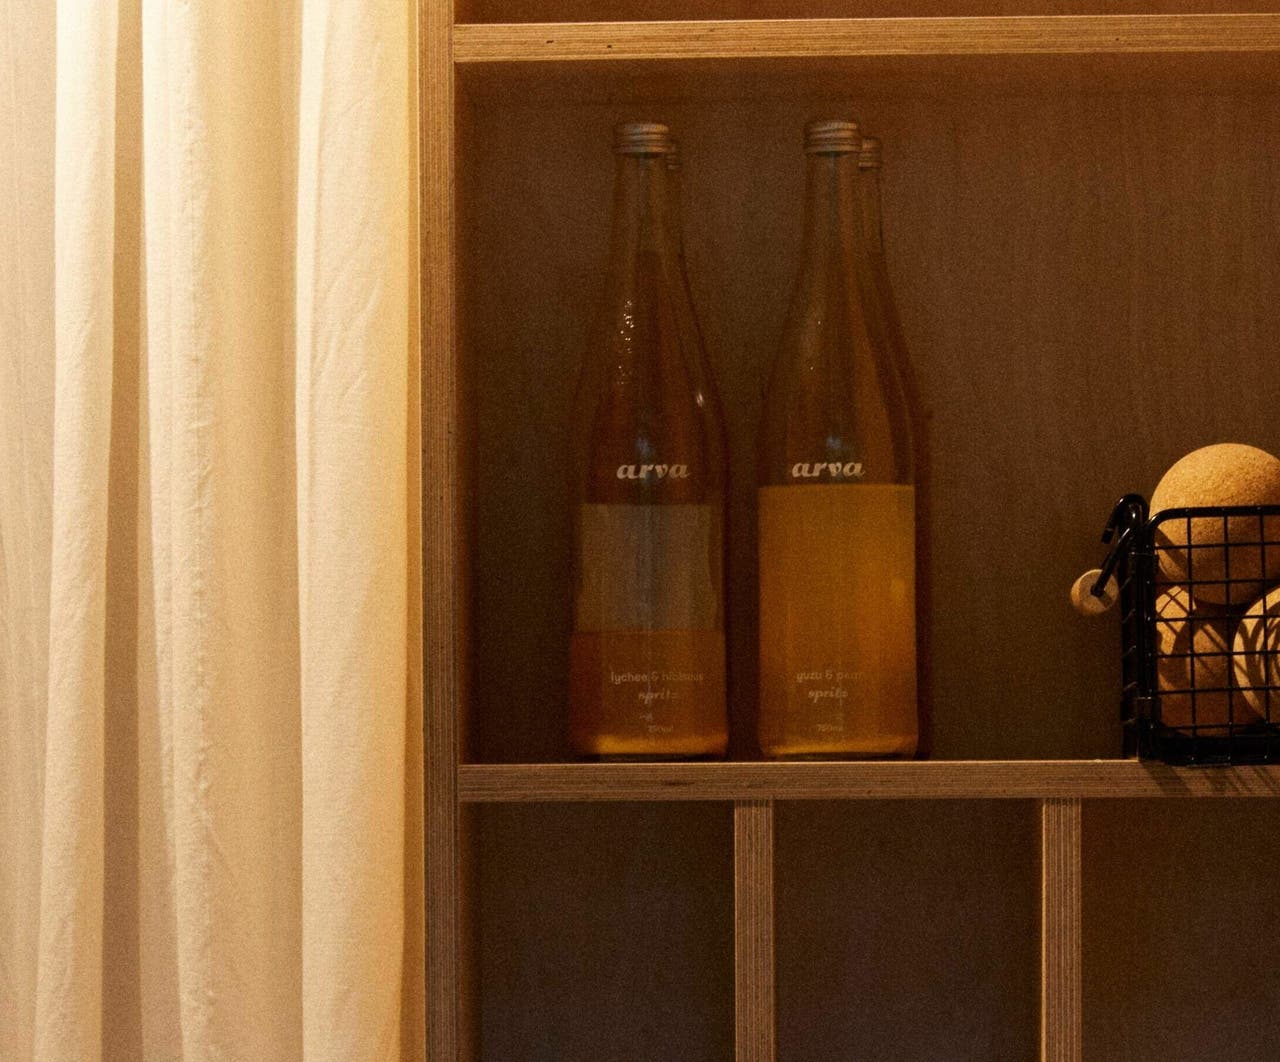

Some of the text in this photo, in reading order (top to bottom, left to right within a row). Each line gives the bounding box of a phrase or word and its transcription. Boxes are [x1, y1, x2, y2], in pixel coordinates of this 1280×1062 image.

[617, 463, 690, 481] arva
[792, 460, 865, 479] arva
[796, 672, 822, 683] yuzu
